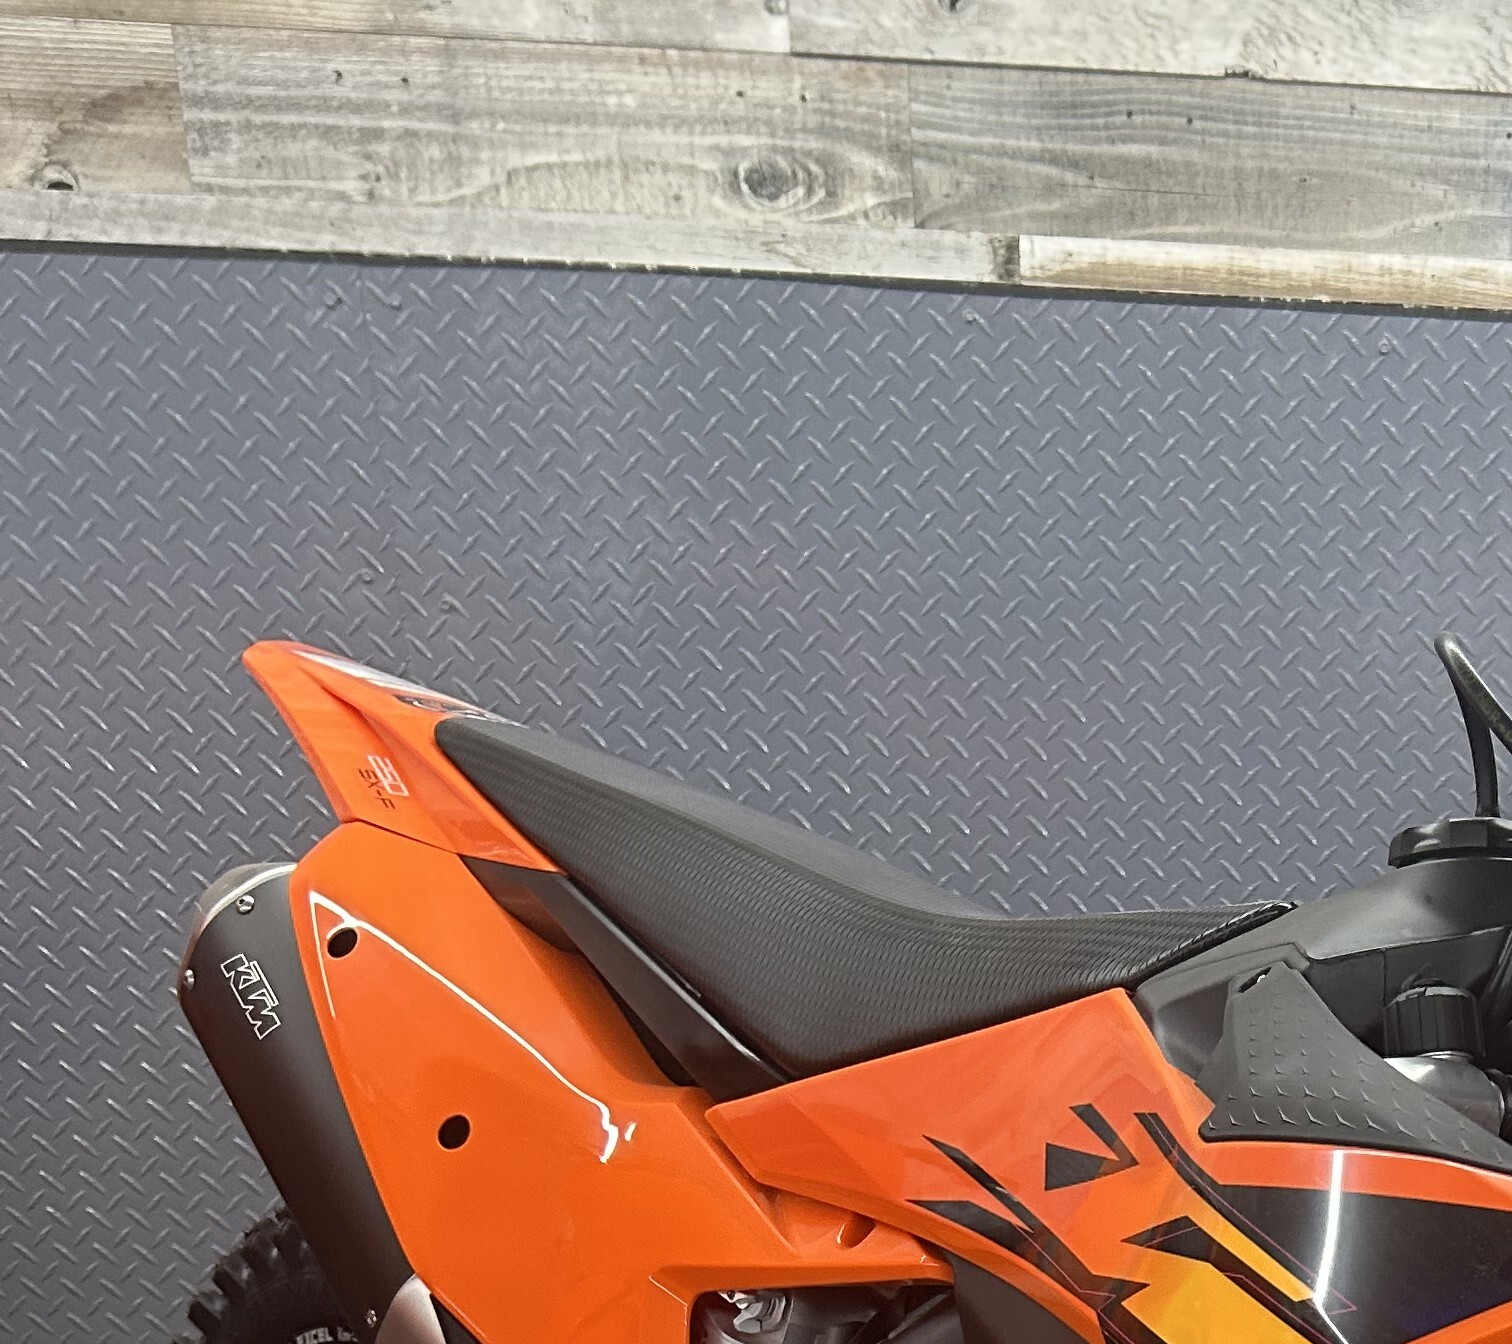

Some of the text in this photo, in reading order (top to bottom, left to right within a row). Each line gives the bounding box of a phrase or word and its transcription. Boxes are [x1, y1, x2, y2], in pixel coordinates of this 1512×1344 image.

[357, 768, 396, 810] SX-F
[367, 754, 410, 797] 250
[220, 953, 281, 1040] KTM
